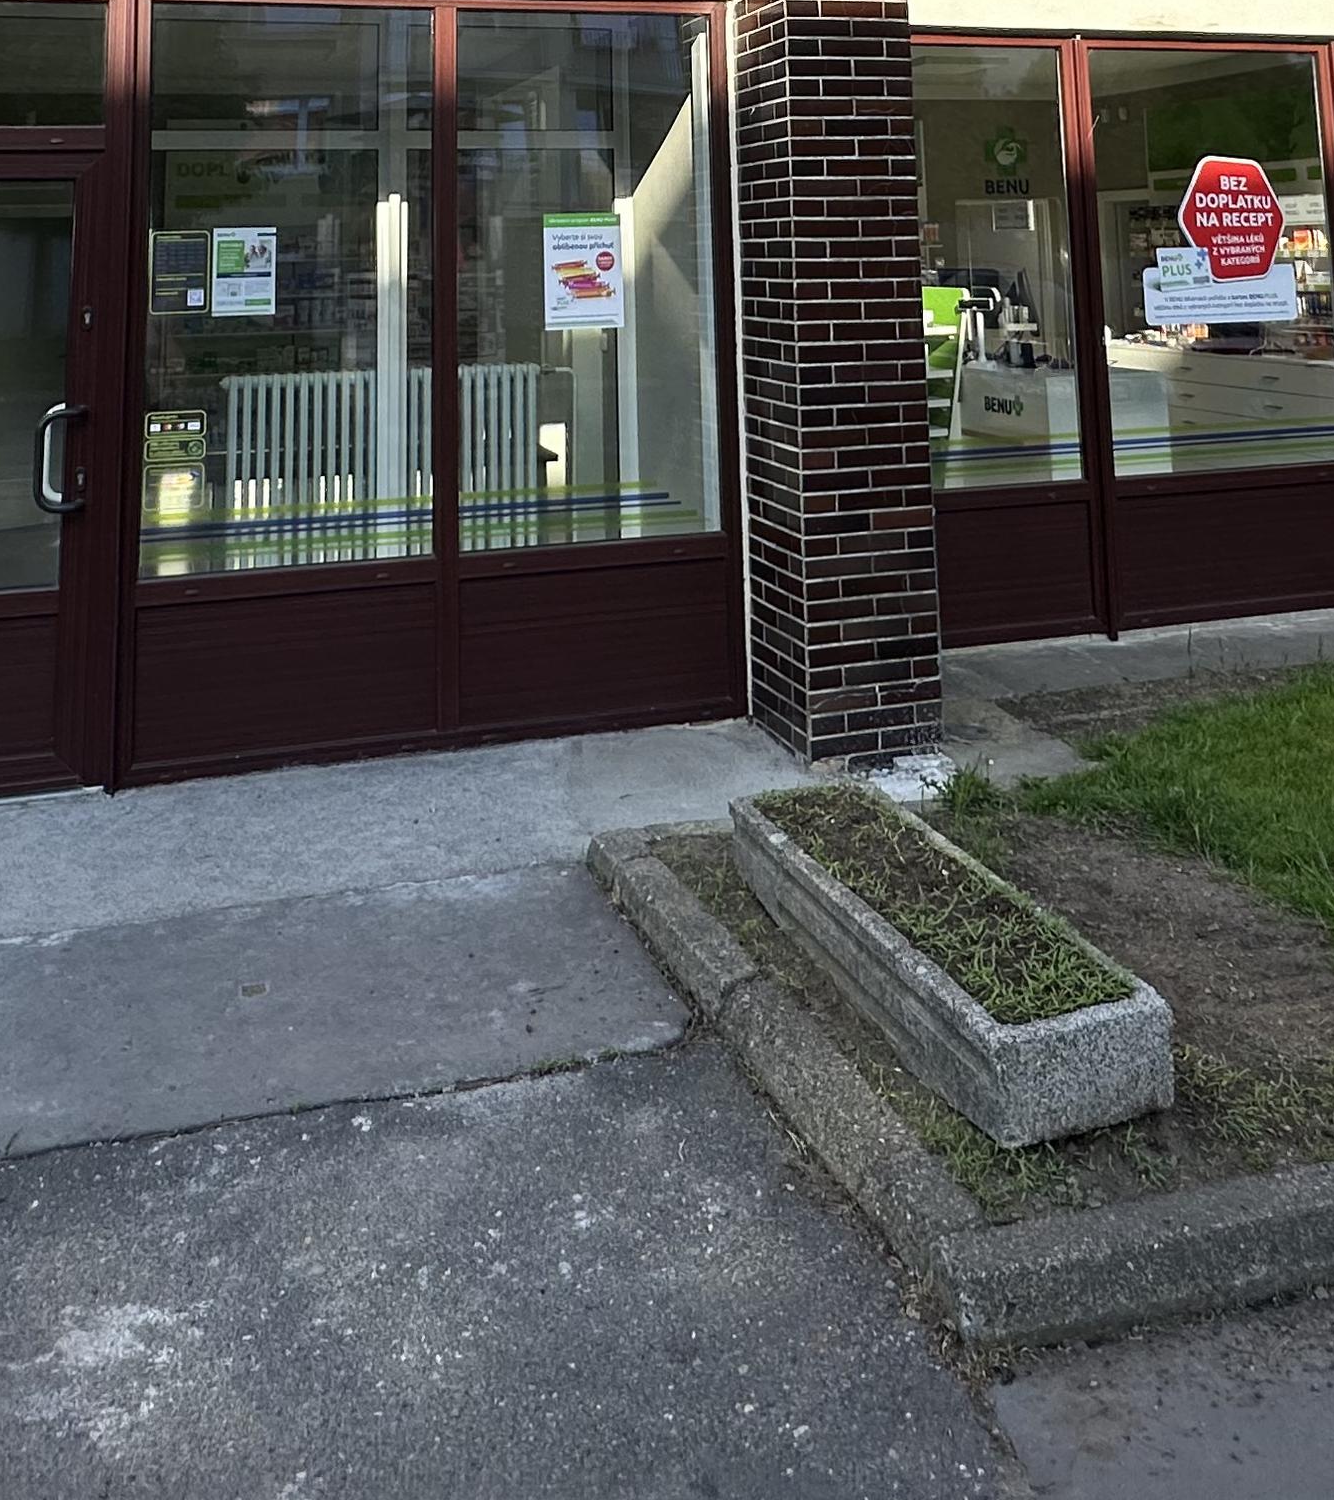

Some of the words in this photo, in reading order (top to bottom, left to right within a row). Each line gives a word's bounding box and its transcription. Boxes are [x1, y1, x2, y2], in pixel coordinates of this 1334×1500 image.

[985, 178, 1030, 195] BENU
[1220, 175, 1248, 191] BEZ
[1195, 193, 1271, 209] DOPLATKU
[1196, 211, 1220, 227] NA
[1222, 211, 1274, 228] RECEPT
[1162, 263, 1192, 277] PLUS
[984, 395, 1012, 415] BENU
